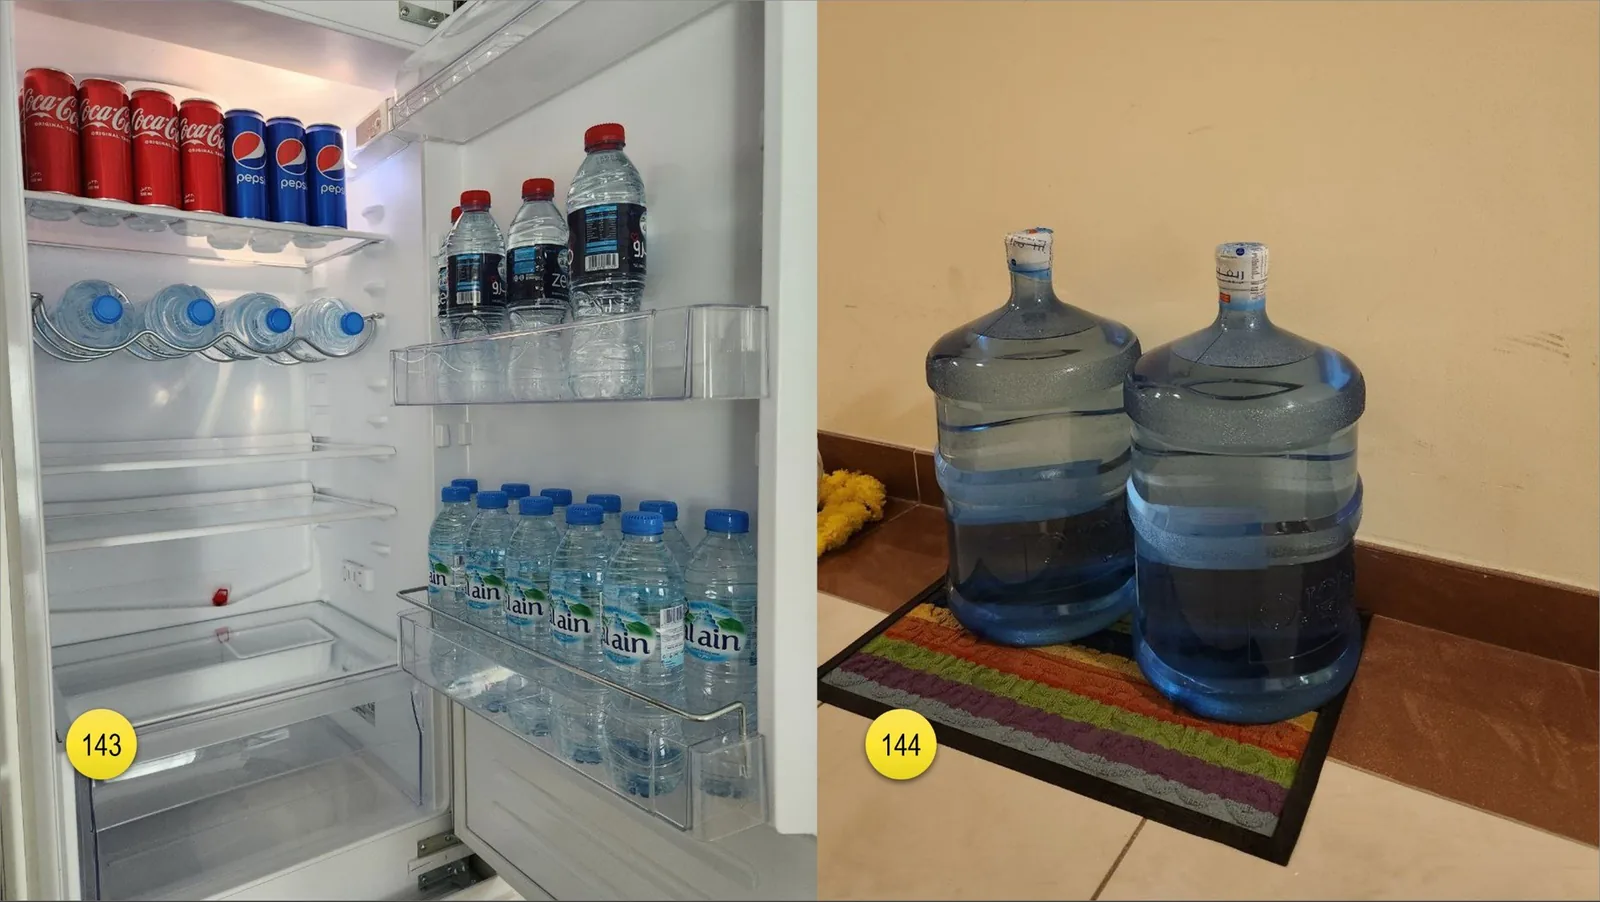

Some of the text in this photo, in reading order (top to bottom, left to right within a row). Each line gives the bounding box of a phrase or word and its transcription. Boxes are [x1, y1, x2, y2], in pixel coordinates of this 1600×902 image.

[34, 121, 64, 130] ORIGINAL
[91, 131, 119, 139] ORIGINAL
[144, 140, 171, 148] ORIGINAL
[472, 583, 501, 600] ain
[512, 598, 543, 616] ain
[557, 613, 591, 634] ain
[612, 631, 650, 655] ain
[698, 628, 742, 652] ain
